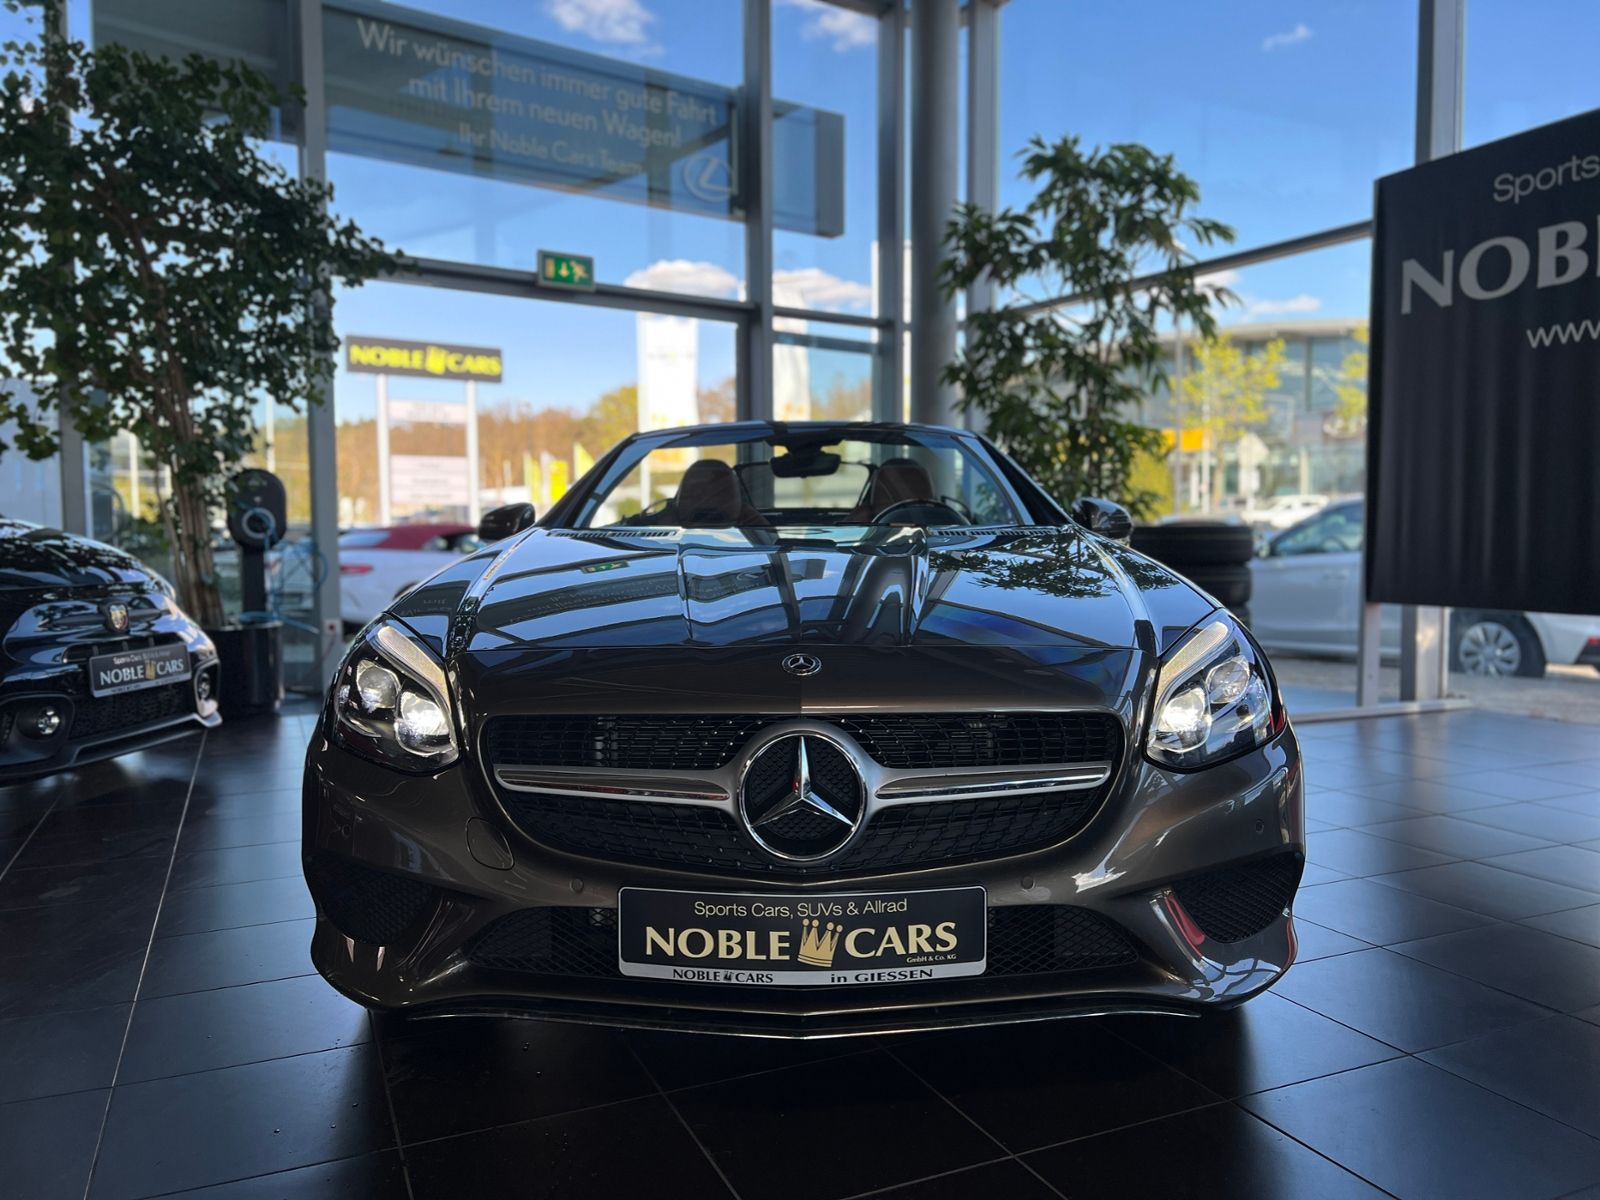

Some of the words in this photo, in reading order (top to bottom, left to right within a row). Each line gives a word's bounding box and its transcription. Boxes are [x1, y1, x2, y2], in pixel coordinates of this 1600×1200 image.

[357, 19, 406, 56] Wir
[413, 42, 536, 85] wünschen
[540, 65, 611, 100] immer
[615, 90, 663, 113] gute
[665, 90, 718, 125] Fahrt
[409, 77, 448, 101] mit
[453, 79, 525, 117] Ihrem
[528, 103, 599, 132] neuen
[459, 122, 487, 145] Ihr
[489, 128, 549, 160] Noble
[551, 139, 596, 168] Cars
[1401, 214, 1600, 315] NOB
[350, 344, 424, 370] NOBLE
[447, 352, 501, 376] CARS
[100, 664, 145, 686] NOBLE
[156, 658, 185, 675] CARS
[694, 901, 748, 918] Sports
[751, 902, 794, 919] Cars,
[797, 902, 842, 917] SUVs
[846, 901, 860, 916] &
[863, 898, 908, 914] Allrad
[645, 926, 791, 960] NOBLE
[844, 921, 958, 958] CARS
[673, 968, 721, 982] NOBLE
[735, 972, 774, 983] CARS
[830, 973, 848, 983] in
[854, 968, 933, 983] GIESSEN
